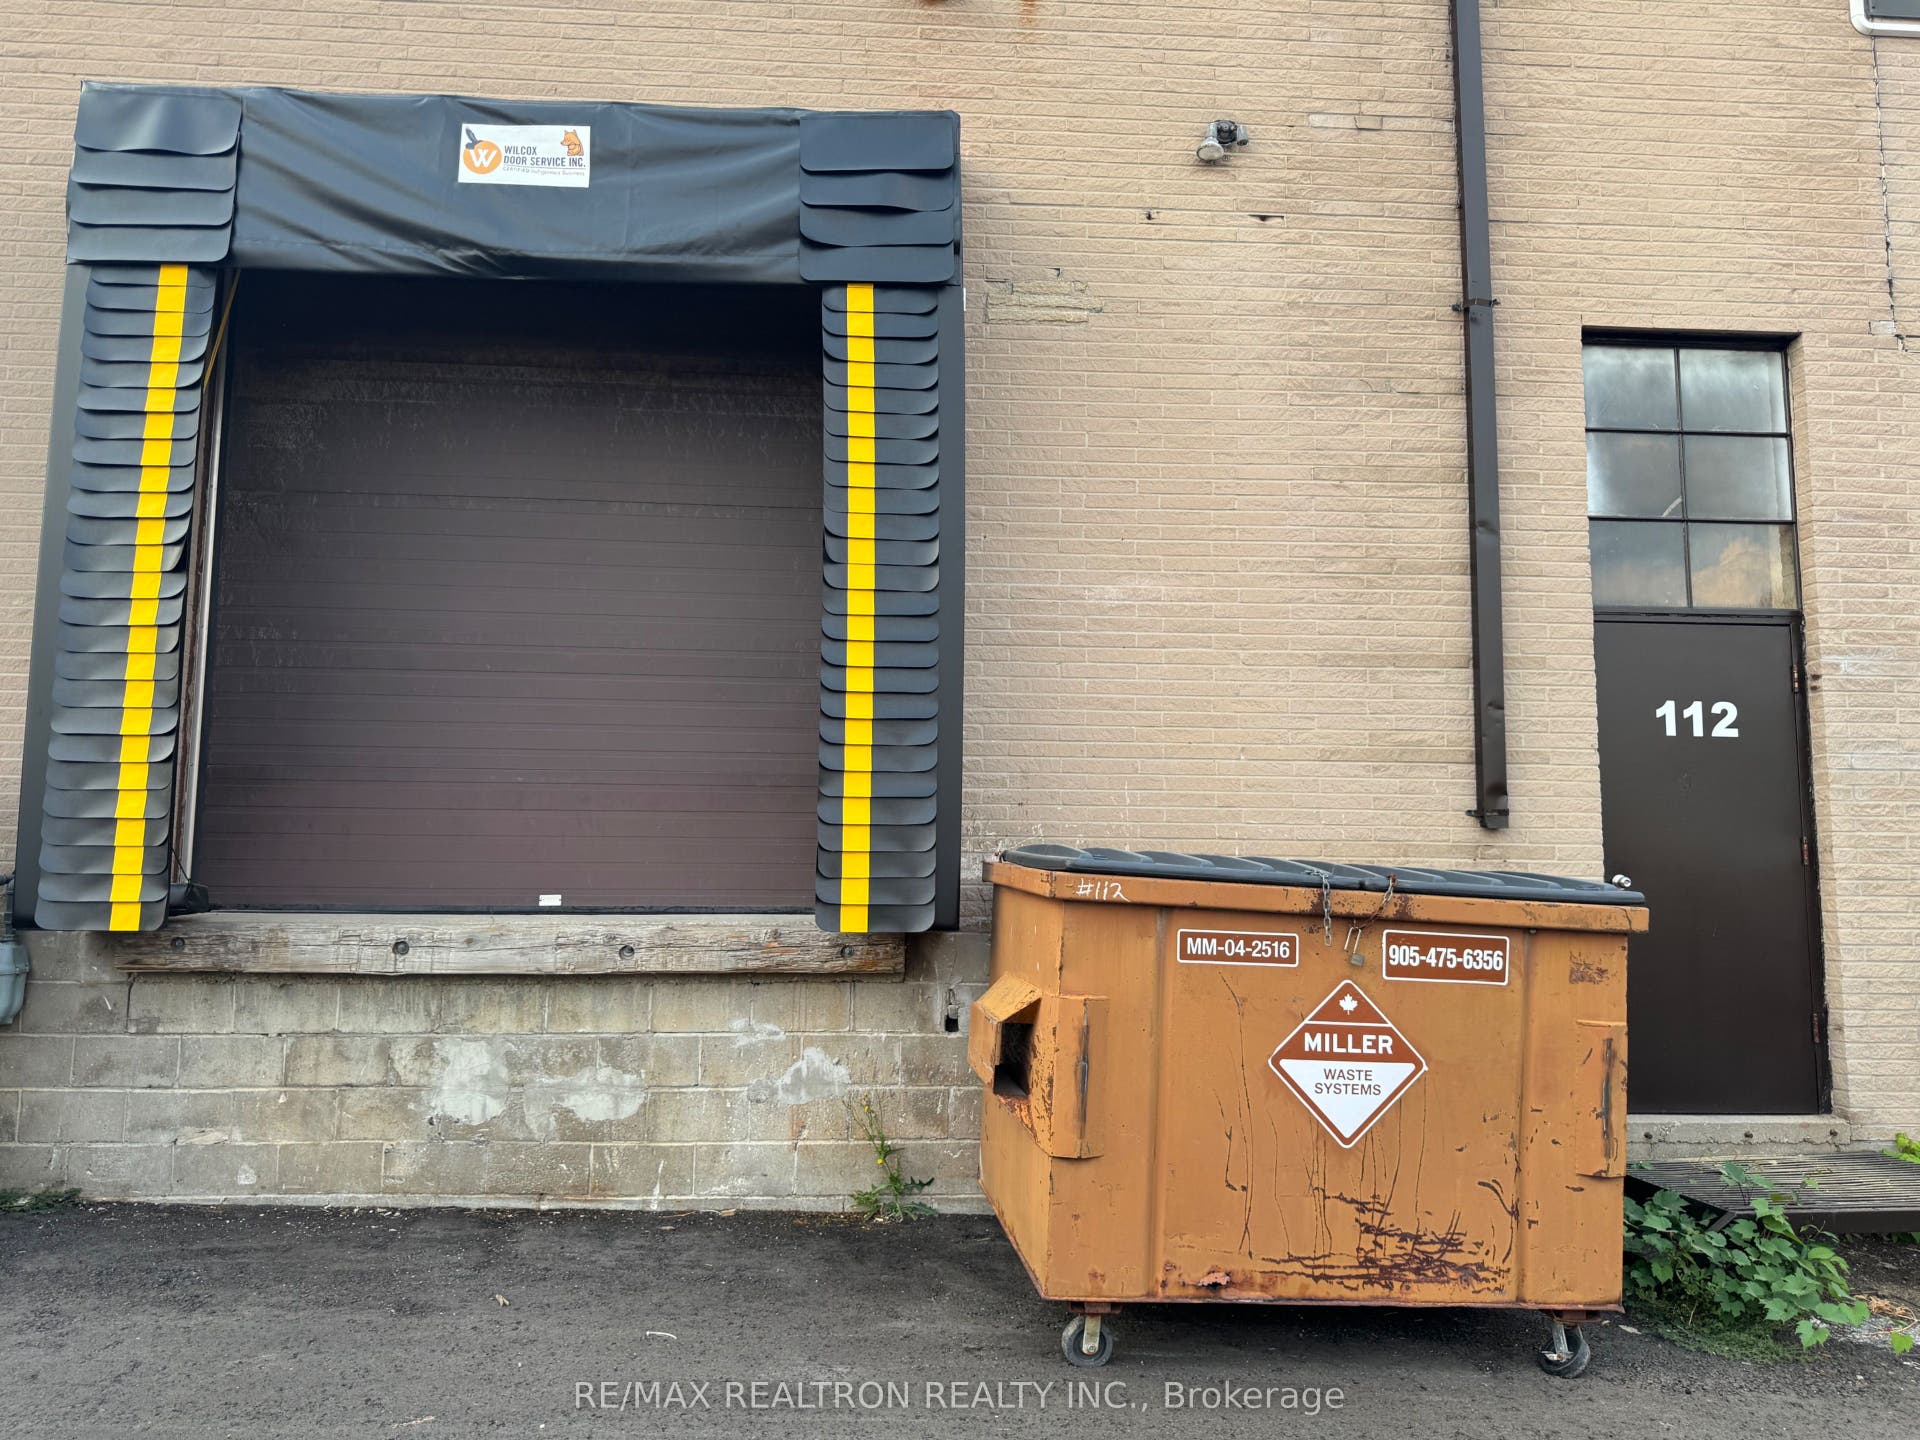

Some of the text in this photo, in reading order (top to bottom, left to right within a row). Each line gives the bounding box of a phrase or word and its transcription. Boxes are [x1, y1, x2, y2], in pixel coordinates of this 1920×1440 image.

[503, 155, 586, 168] DOOR SERVICE INC.
[504, 145, 538, 156] WILCOX
[1655, 699, 1739, 738] 112
[1076, 877, 1131, 903] #112
[1186, 937, 1290, 959] MM-04-2516
[1388, 944, 1504, 971] 905-475-6356
[1303, 1032, 1394, 1055] MILLER
[1323, 1068, 1373, 1081] WASTE
[1314, 1083, 1382, 1096] SYSTEMS
